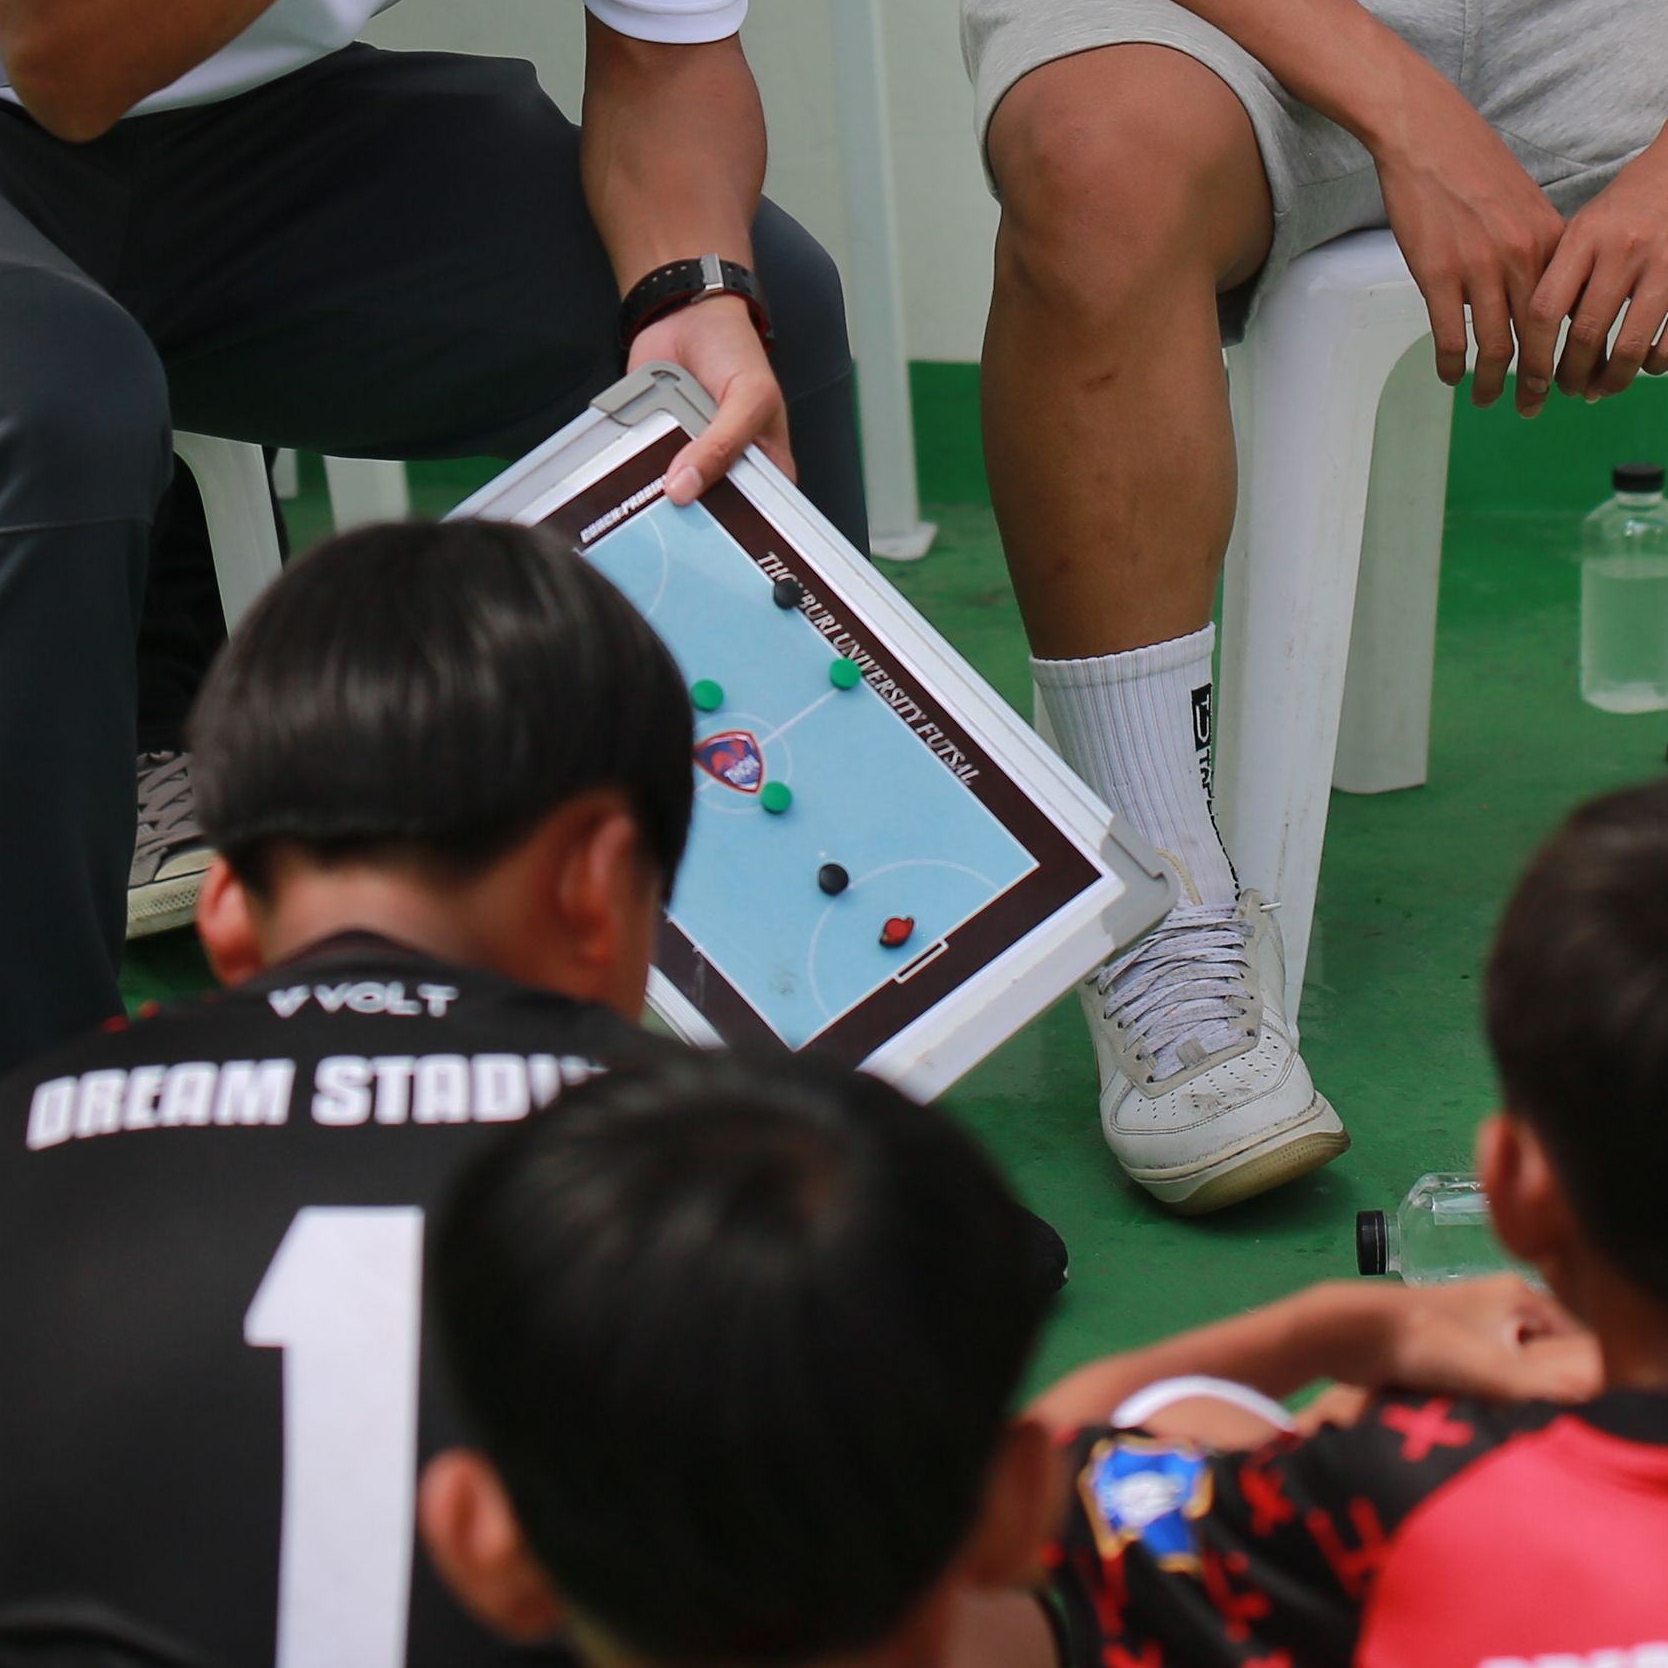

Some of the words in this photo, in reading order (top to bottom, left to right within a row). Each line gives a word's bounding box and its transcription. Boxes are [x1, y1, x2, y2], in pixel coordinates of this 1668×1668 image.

[757, 550, 843, 636] THOBURI
[832, 631, 928, 724] UNIVERSITY
[915, 722, 980, 786] FUTSAL
[314, 981, 459, 1018] VOLT
[25, 1058, 296, 1151] DREAM
[310, 1052, 612, 1127] STADI
[242, 1204, 425, 1668] 1
